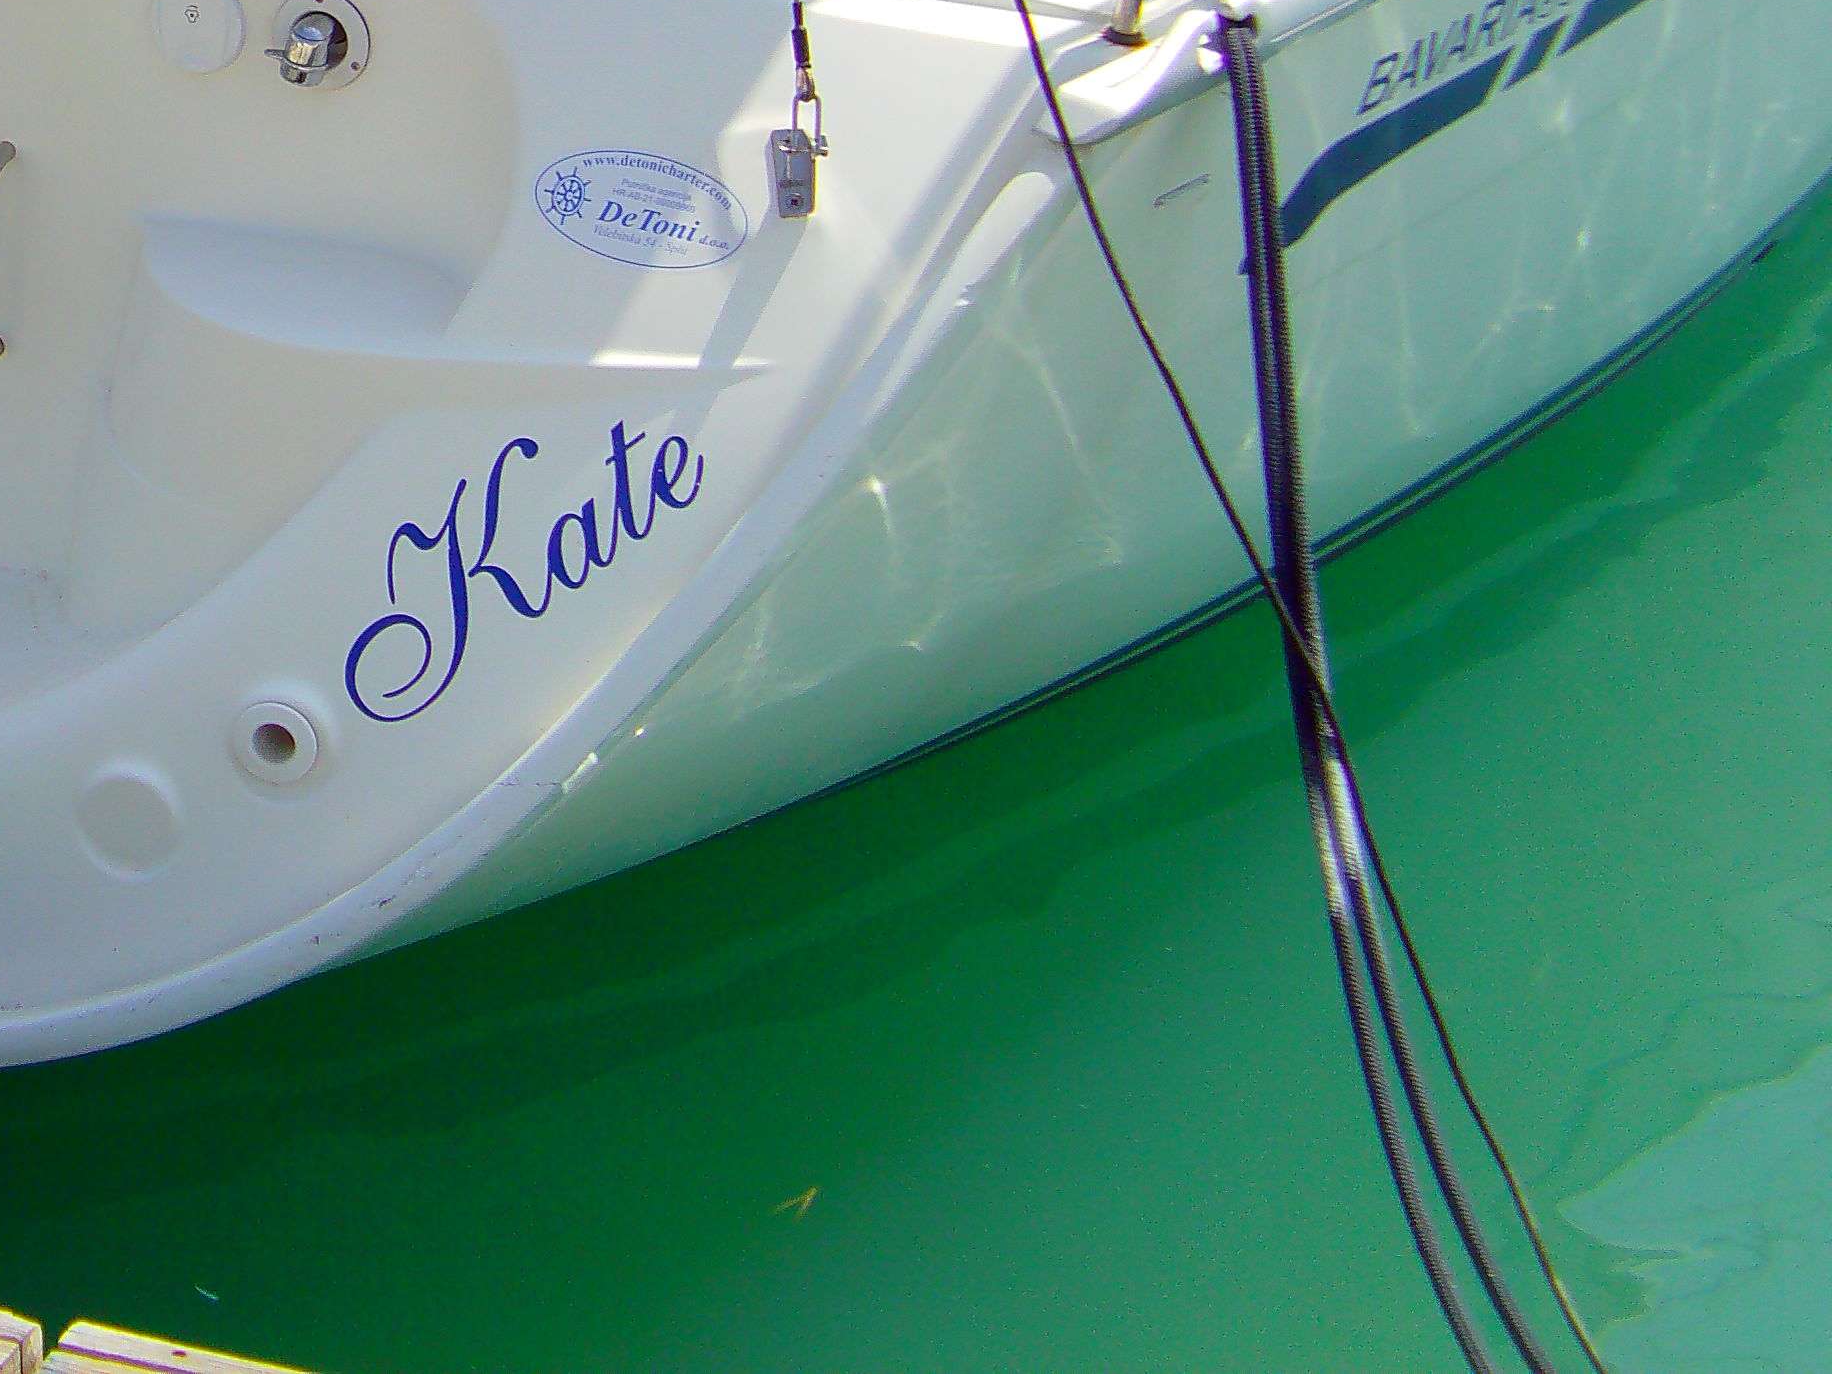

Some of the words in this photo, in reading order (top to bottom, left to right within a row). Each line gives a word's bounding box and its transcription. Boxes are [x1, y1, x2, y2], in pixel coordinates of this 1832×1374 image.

[583, 154, 733, 211] www.detonicharter.com
[698, 235, 730, 250] d.o.o.
[344, 420, 704, 722] Kate
